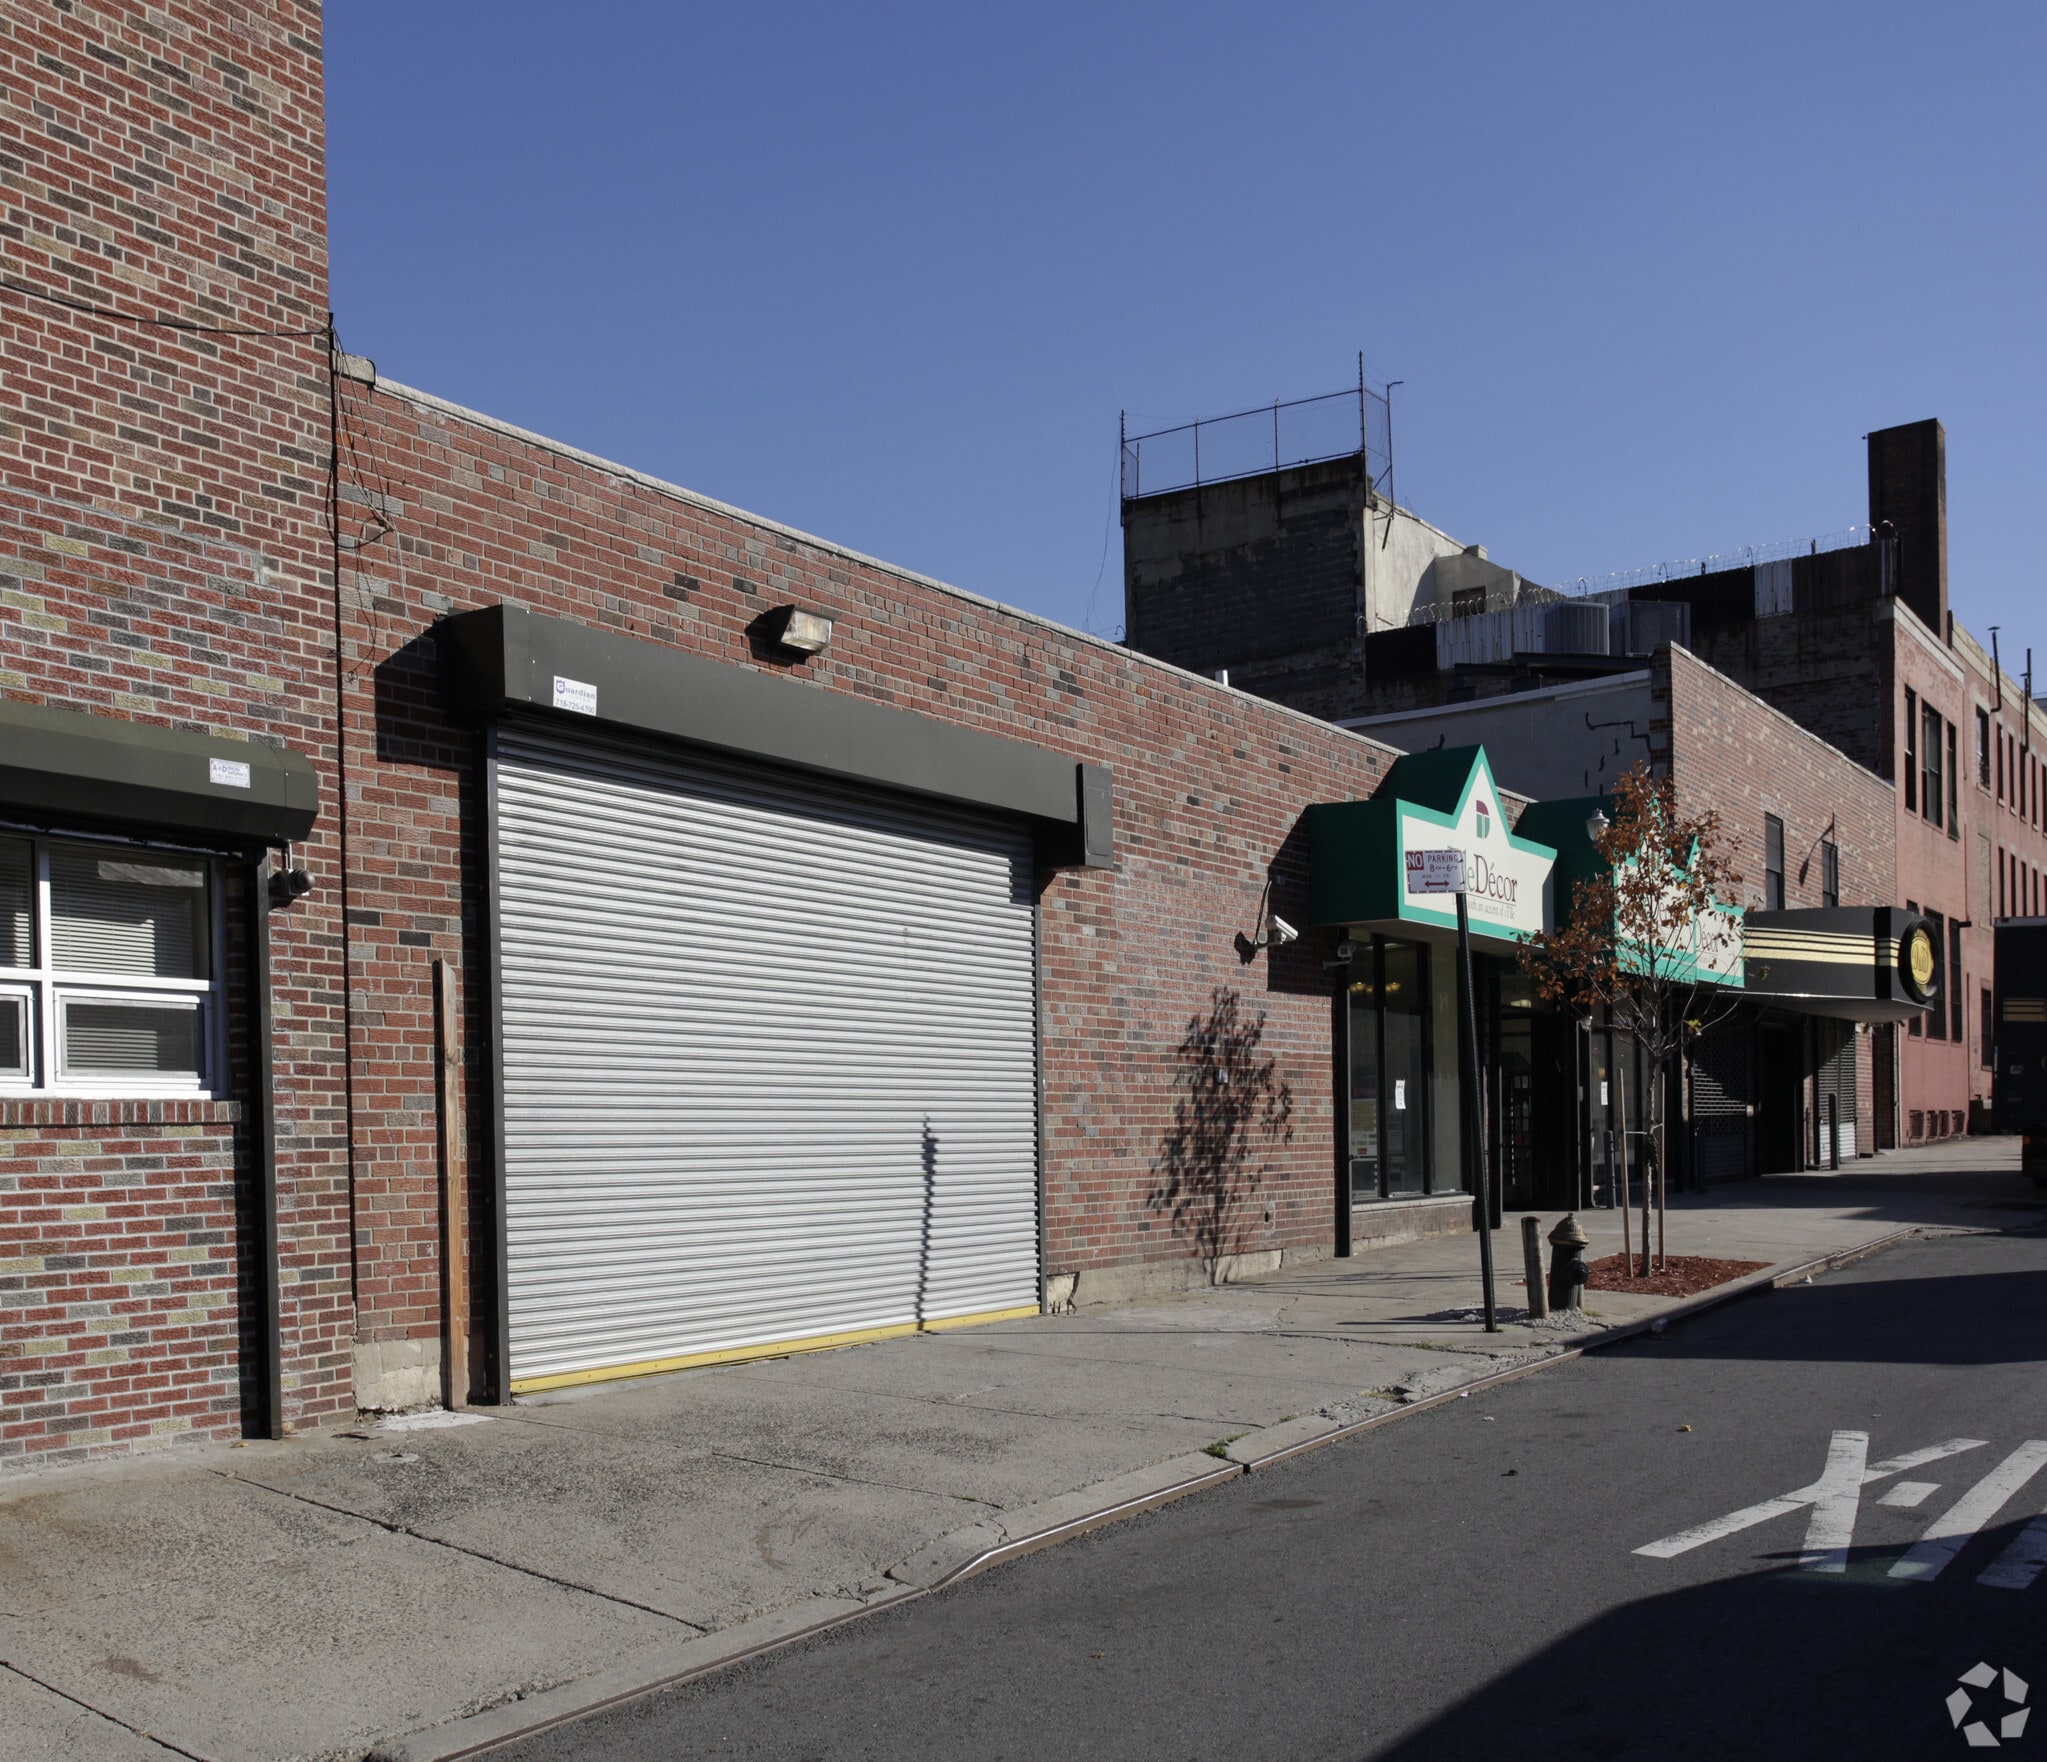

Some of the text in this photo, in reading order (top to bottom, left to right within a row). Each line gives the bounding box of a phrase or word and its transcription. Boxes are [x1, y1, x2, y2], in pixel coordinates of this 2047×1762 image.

[556, 680, 595, 699] Guardian
[1408, 854, 1458, 868] NO PARKING
